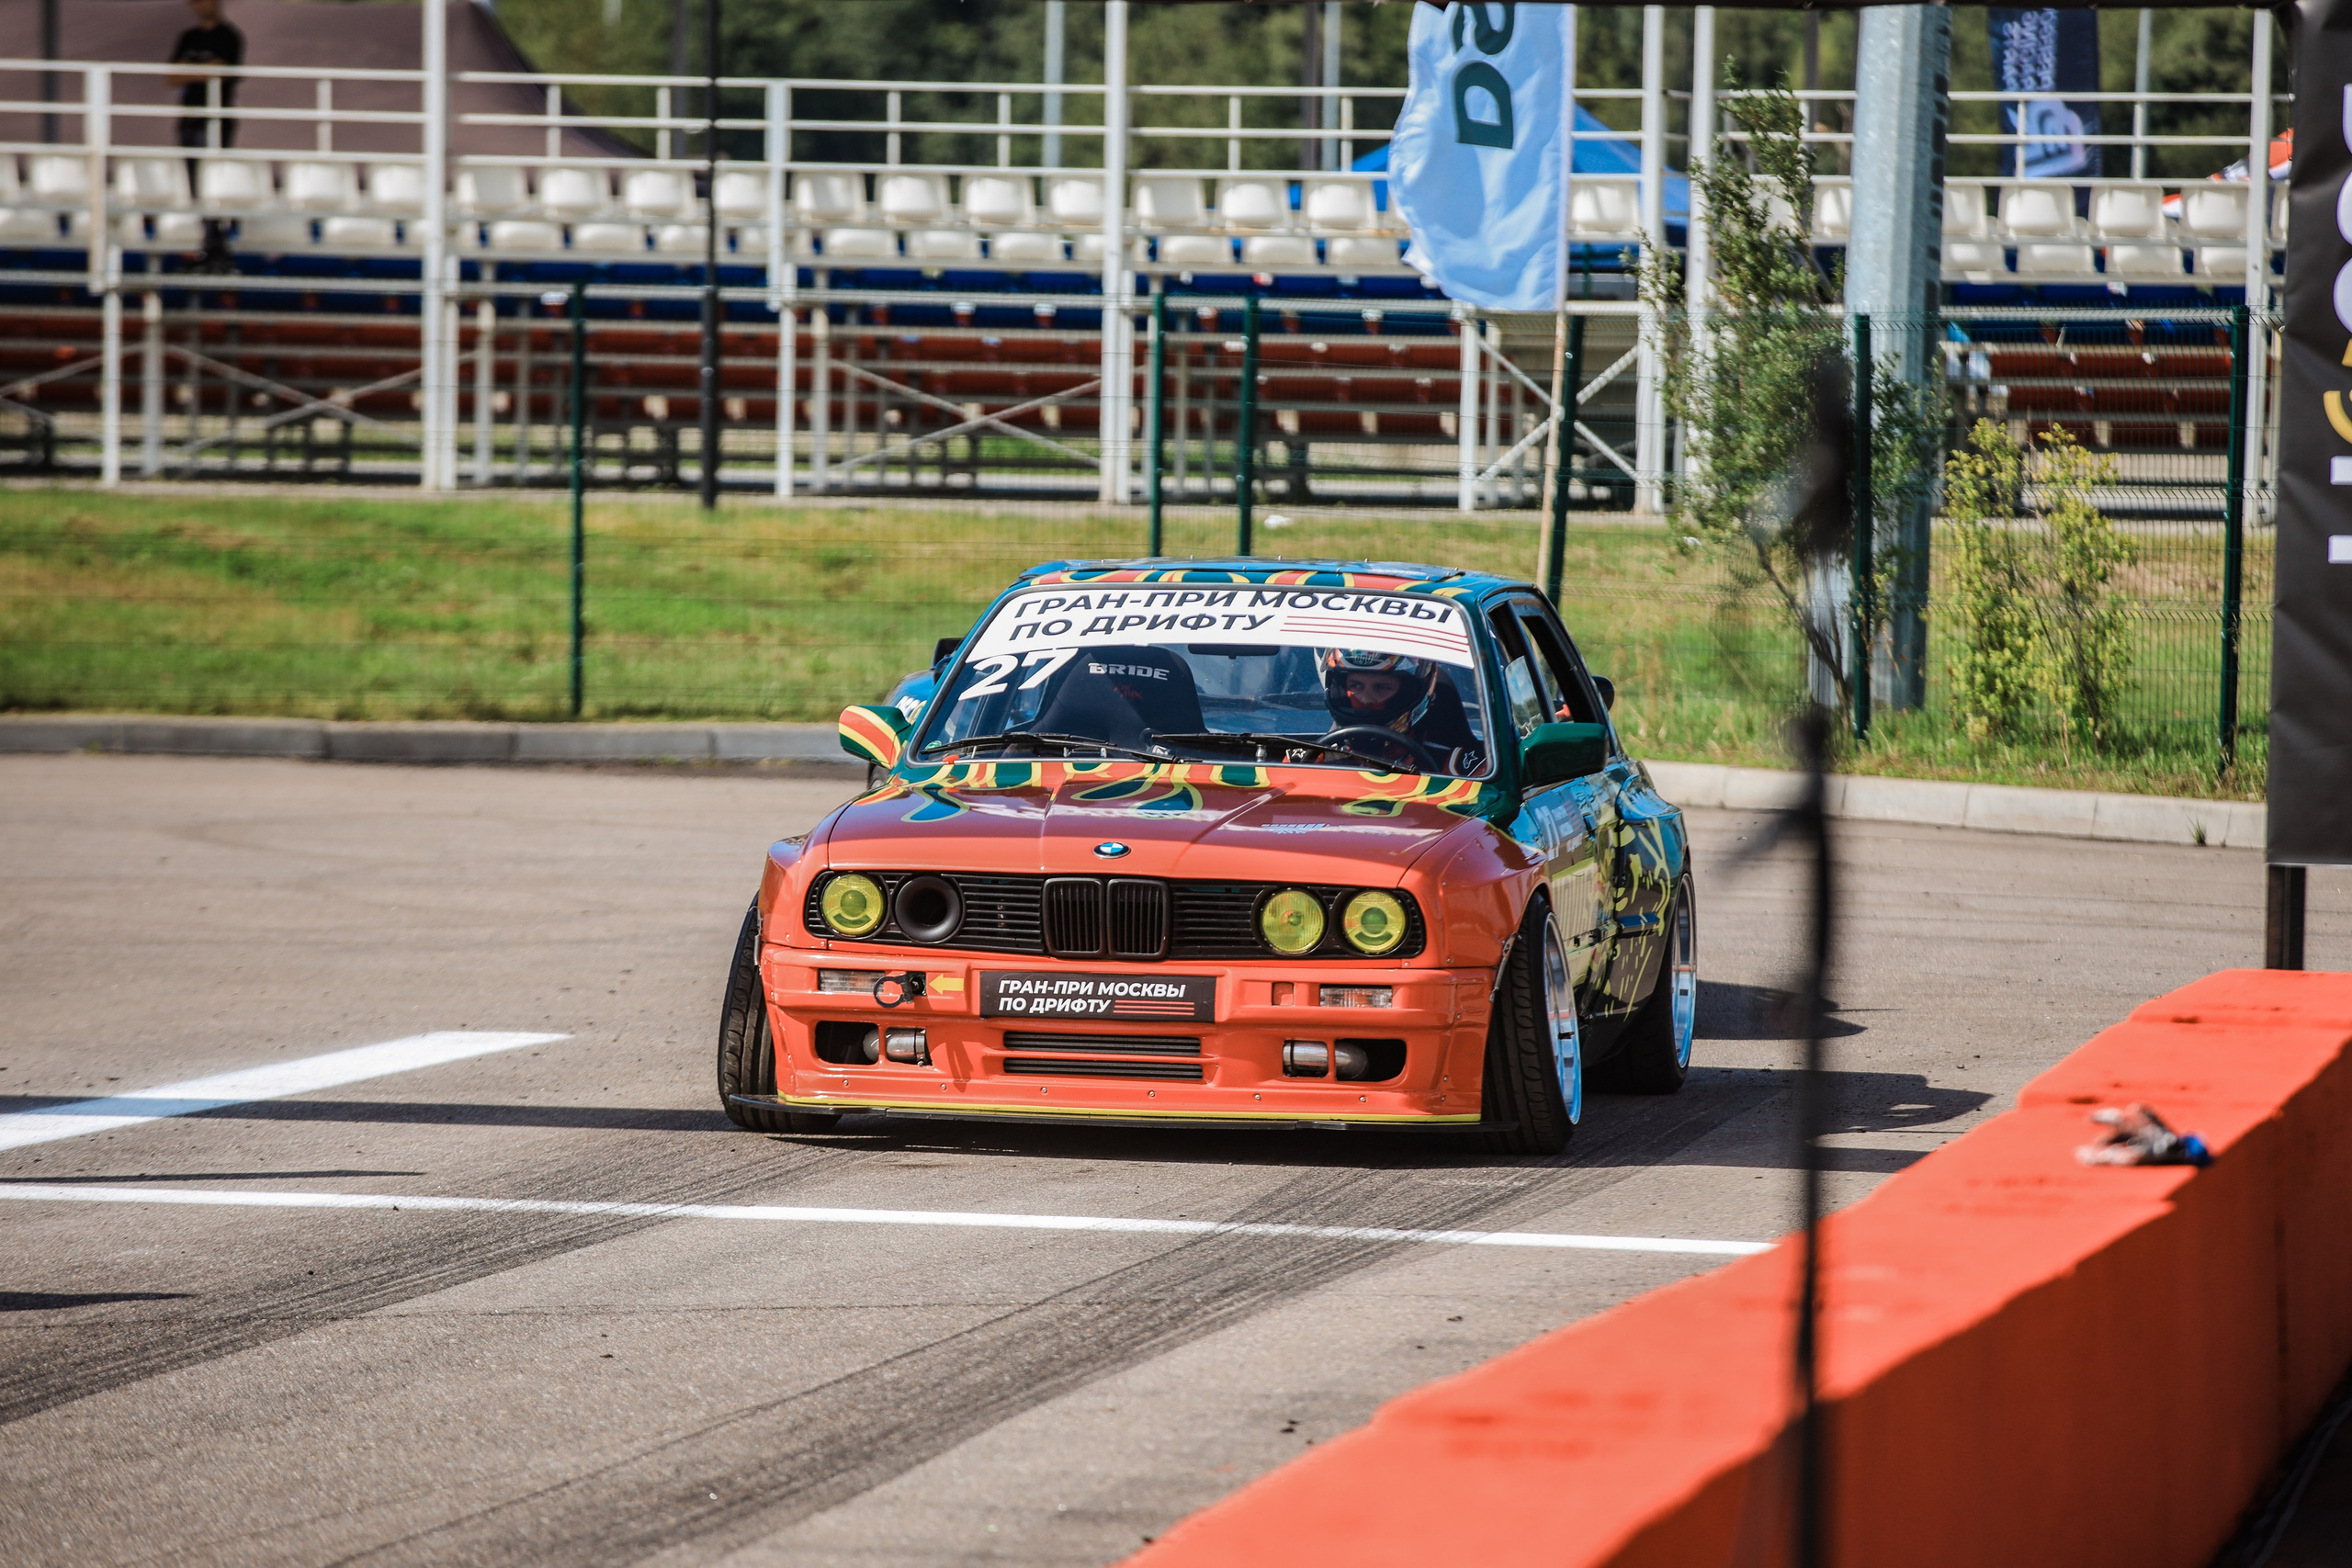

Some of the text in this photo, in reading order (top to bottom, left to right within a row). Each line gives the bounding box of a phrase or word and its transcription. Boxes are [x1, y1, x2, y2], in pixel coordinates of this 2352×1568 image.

[1014, 591, 1453, 624] ГРАН-ПРИ МОСКВЫ
[1009, 613, 1275, 641] ПО ДРИФТУ
[957, 647, 1080, 701] 27
[1088, 662, 1170, 681] BRIDE
[999, 979, 1187, 998] ГРАН-ПРИ МОСКВЫ
[999, 998, 1112, 1014] ПО ДРИФТУ
